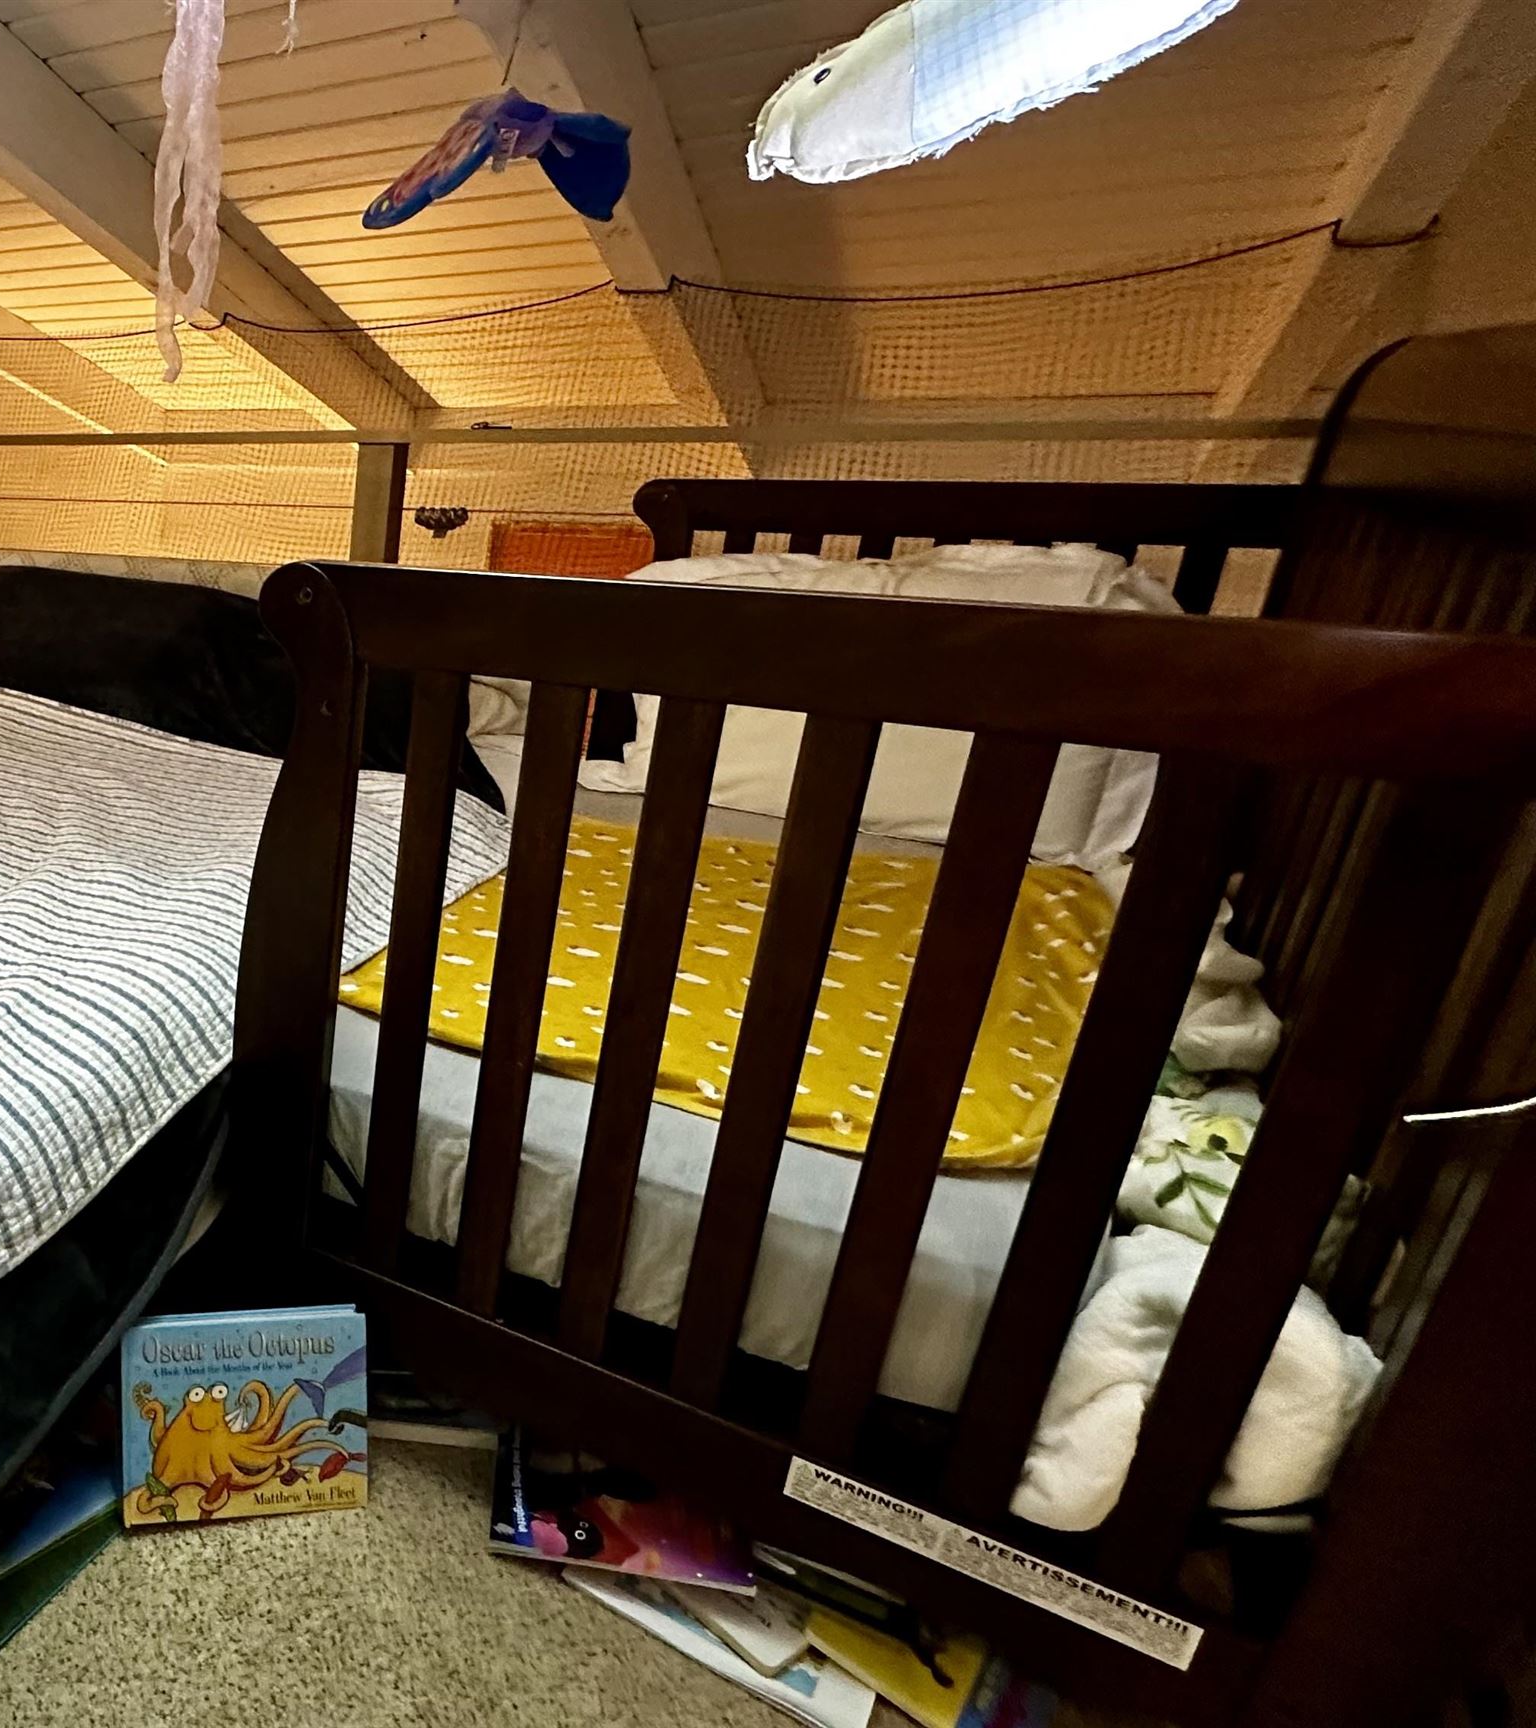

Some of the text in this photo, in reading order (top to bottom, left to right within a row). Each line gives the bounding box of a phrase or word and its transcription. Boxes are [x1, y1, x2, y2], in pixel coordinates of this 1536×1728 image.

[142, 1329, 335, 1364] Oscar the Octopus
[160, 1367, 180, 1377] Book
[183, 1366, 206, 1376] About
[222, 1362, 252, 1374] Months
[262, 1361, 276, 1372] the
[277, 1361, 293, 1371] Year
[254, 1490, 301, 1505] Matthew
[306, 1488, 326, 1502] Van
[330, 1486, 356, 1500] Fleet
[814, 1468, 924, 1522] WARNING!!!
[966, 1535, 1189, 1637] AVERTISSEMENT!!!
